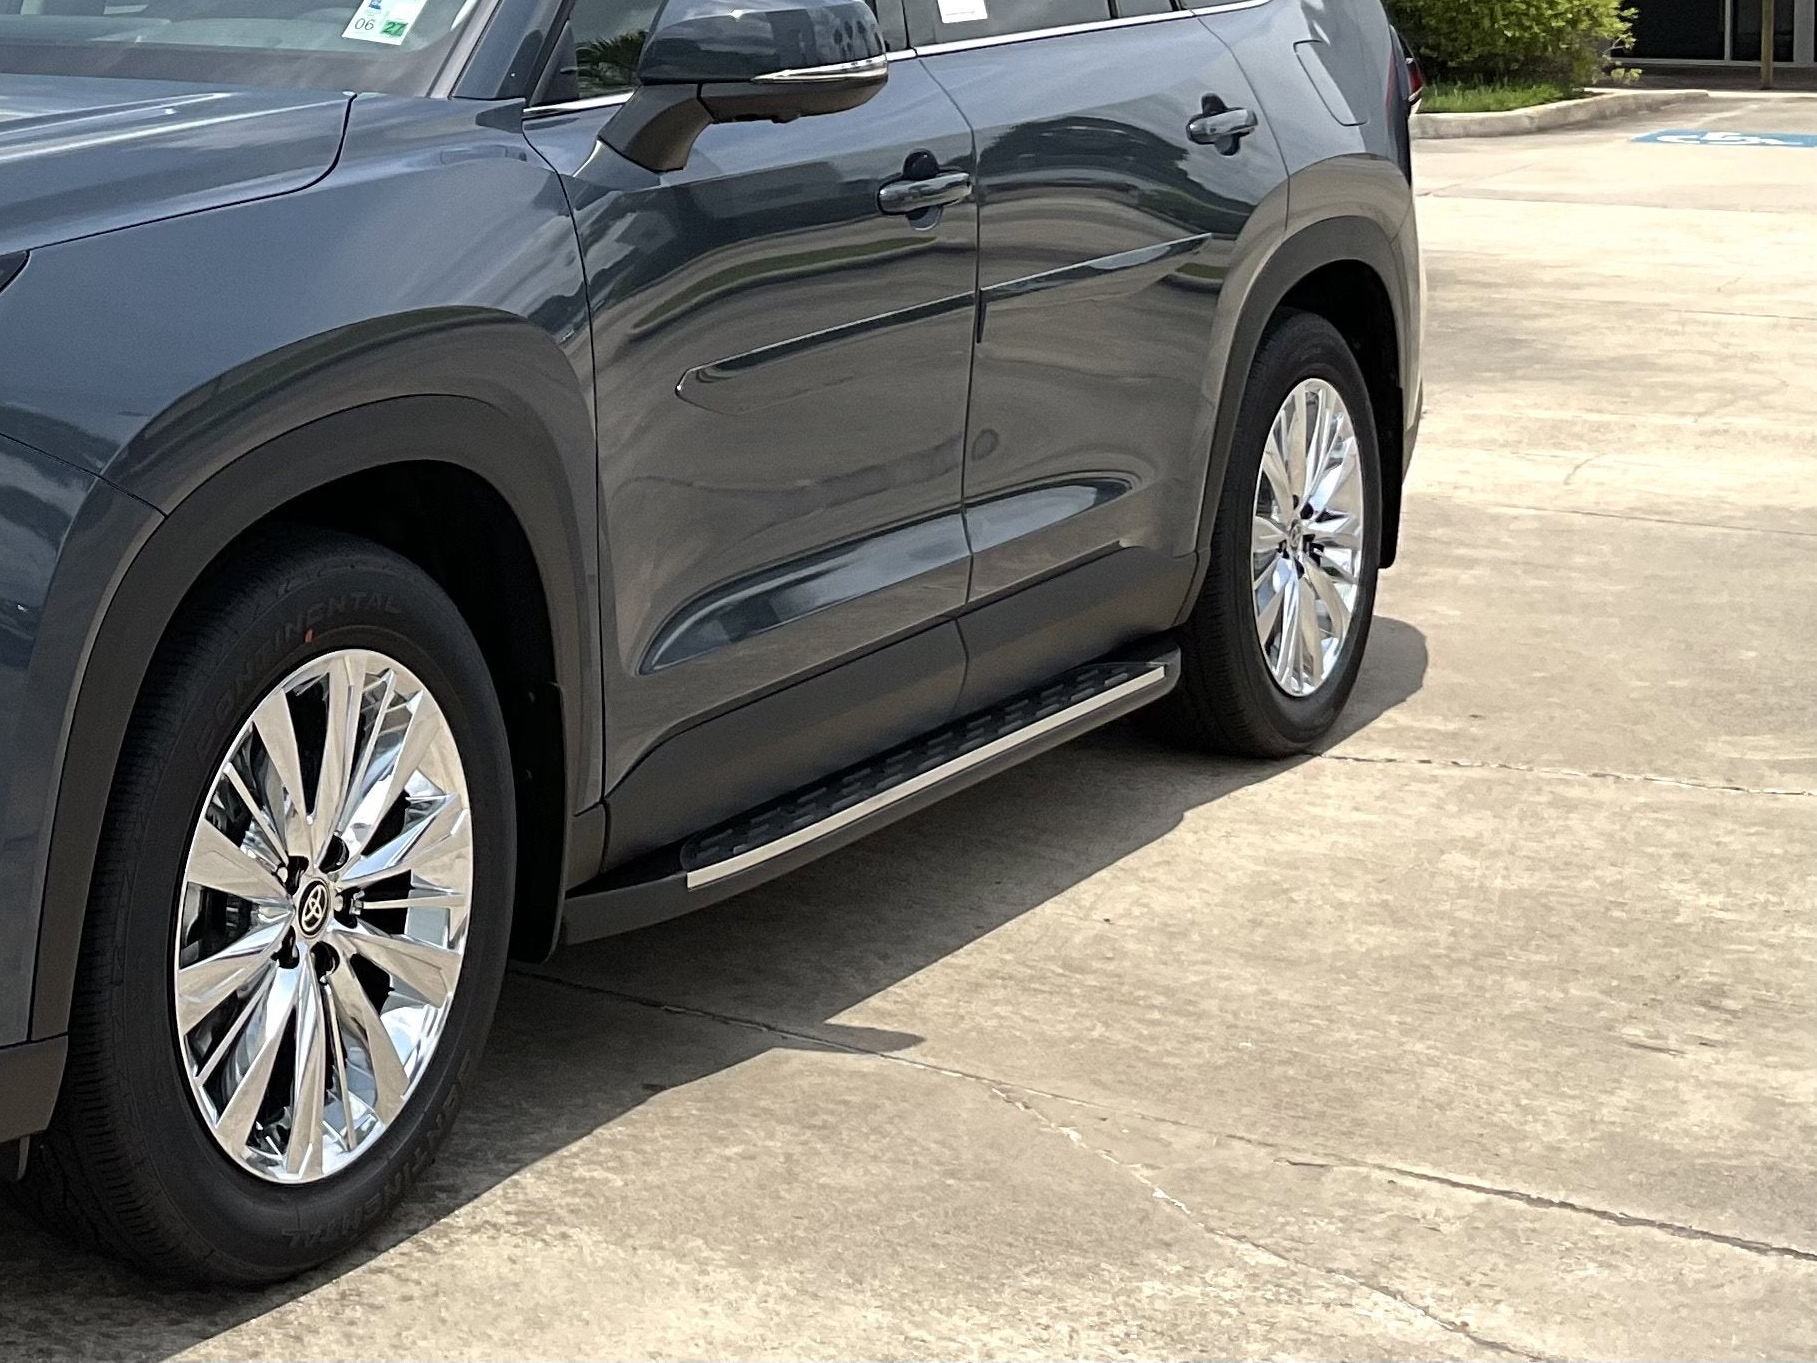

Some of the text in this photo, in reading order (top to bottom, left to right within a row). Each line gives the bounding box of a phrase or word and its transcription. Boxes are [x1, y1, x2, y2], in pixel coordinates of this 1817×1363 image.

[354, 17, 409, 36] 06 27
[196, 591, 401, 763] CONTINENTAL
